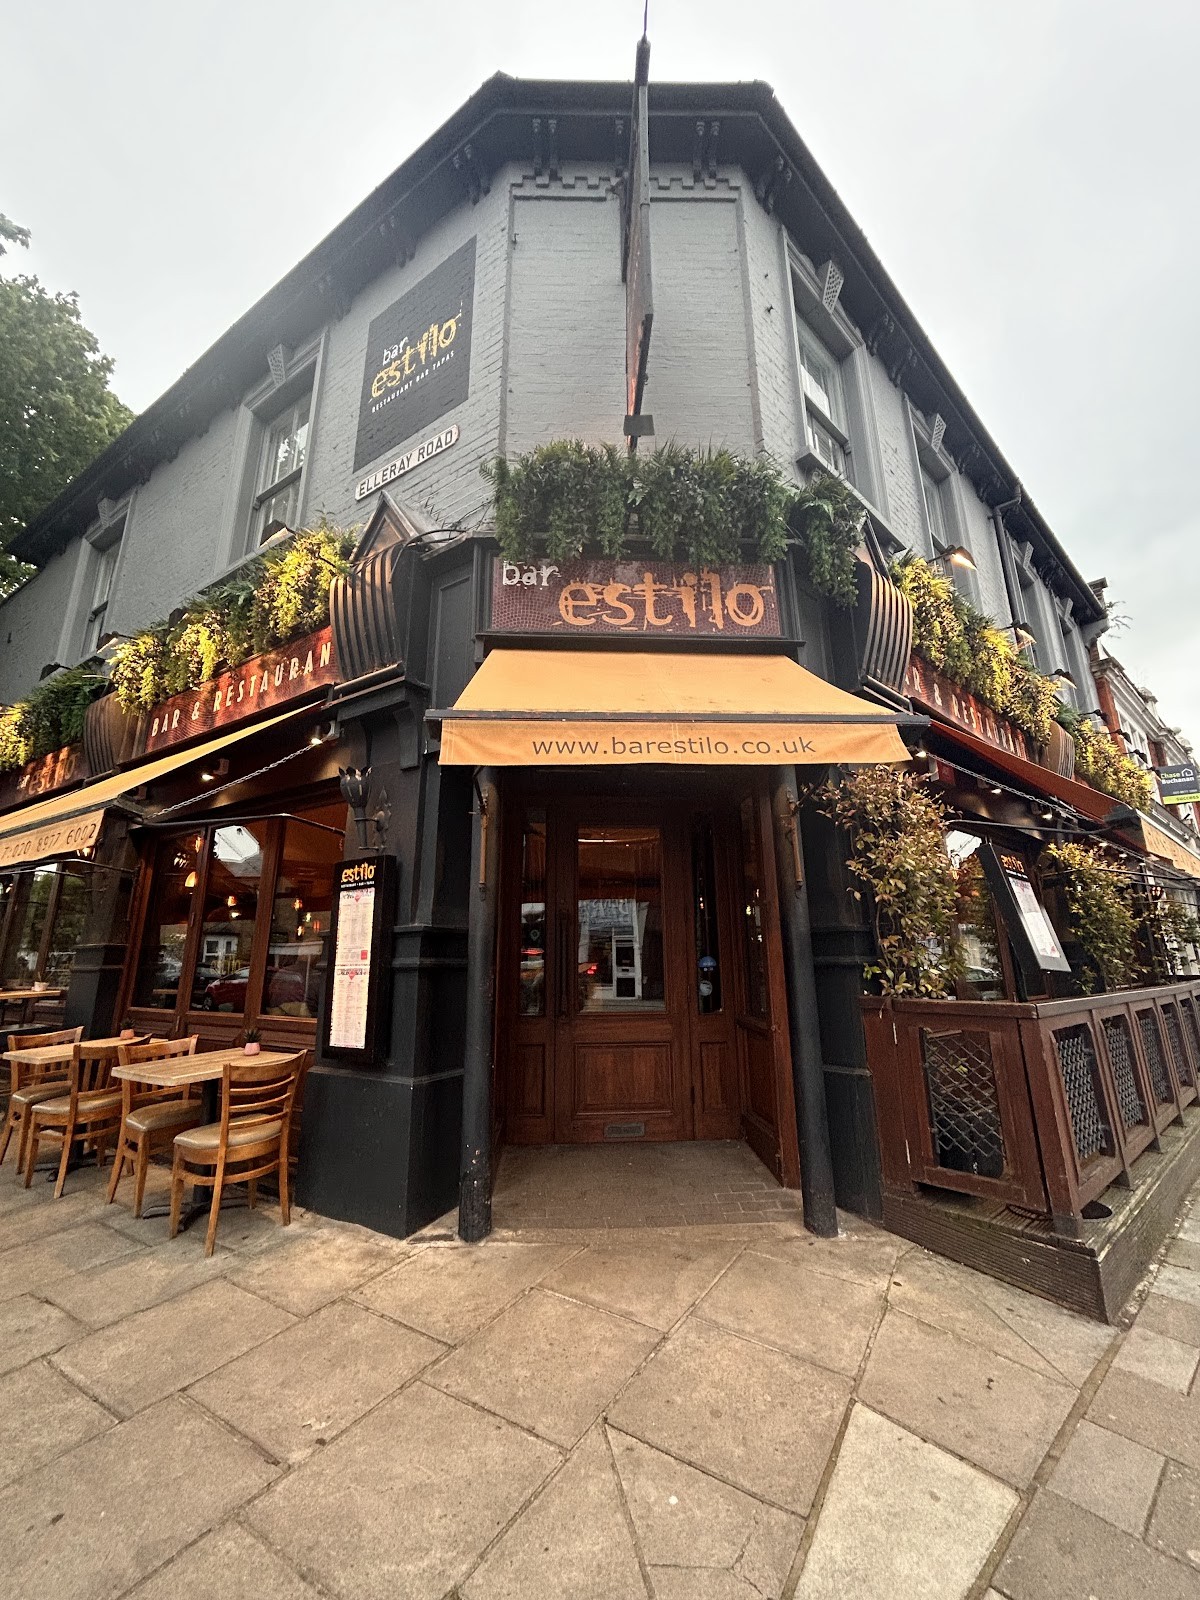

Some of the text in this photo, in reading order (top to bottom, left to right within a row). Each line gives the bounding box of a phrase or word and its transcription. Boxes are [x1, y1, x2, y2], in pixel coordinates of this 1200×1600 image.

[371, 318, 457, 398] estilo
[382, 337, 408, 366] bar
[372, 350, 454, 413] RESTAURANT BAR TAPAS
[358, 430, 453, 497] ELLERAY ROAD
[502, 561, 559, 587] bar
[558, 567, 765, 629] estilo
[151, 708, 180, 737] BAR
[191, 701, 200, 721] &
[532, 737, 817, 755] www.barestilo.co.uk
[1161, 777, 1195, 785] Buchanan
[66, 823, 97, 845] 6002
[341, 862, 376, 882] estilo
